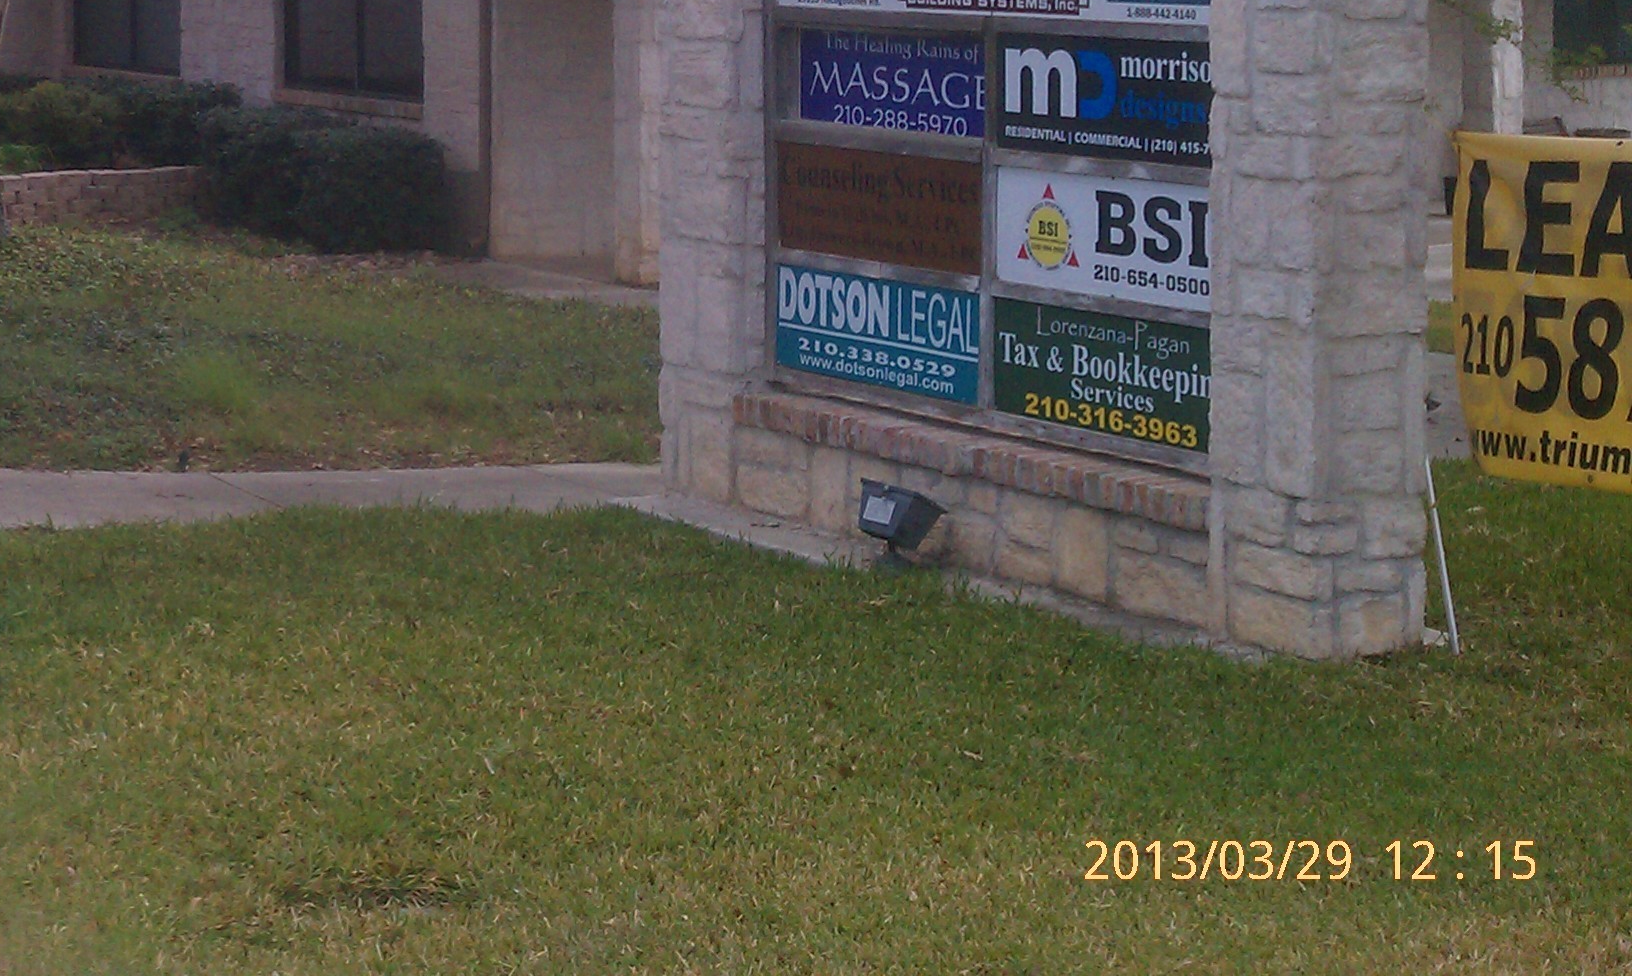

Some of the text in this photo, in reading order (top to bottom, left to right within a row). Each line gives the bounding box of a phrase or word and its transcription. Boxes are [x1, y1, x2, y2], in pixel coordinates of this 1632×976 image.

[824, 32, 850, 50] The
[855, 34, 912, 59] Healing
[964, 44, 979, 64] of
[809, 61, 985, 110] MASSAGE
[833, 104, 968, 137] 210-288-5970
[1120, 89, 1207, 129] designs
[1005, 125, 1067, 142] RESIDENTIAL
[1074, 131, 1143, 150] COMMERCIAL
[1150, 138, 1178, 155] (210)
[1038, 220, 1059, 237] BSI
[1095, 190, 1209, 268] BSI
[1093, 264, 1210, 296] 210-654-0500
[778, 266, 979, 355] DOTSON LEGAL
[998, 331, 1040, 368] Tax
[1045, 345, 1064, 373] &
[1035, 305, 1190, 360] Lorenzana-Pagan
[798, 337, 956, 378] 210.338.0529
[799, 353, 954, 394] www.dotsonlegal.com
[1070, 377, 1155, 413] Services
[1024, 392, 1198, 448] 210-316-3963
